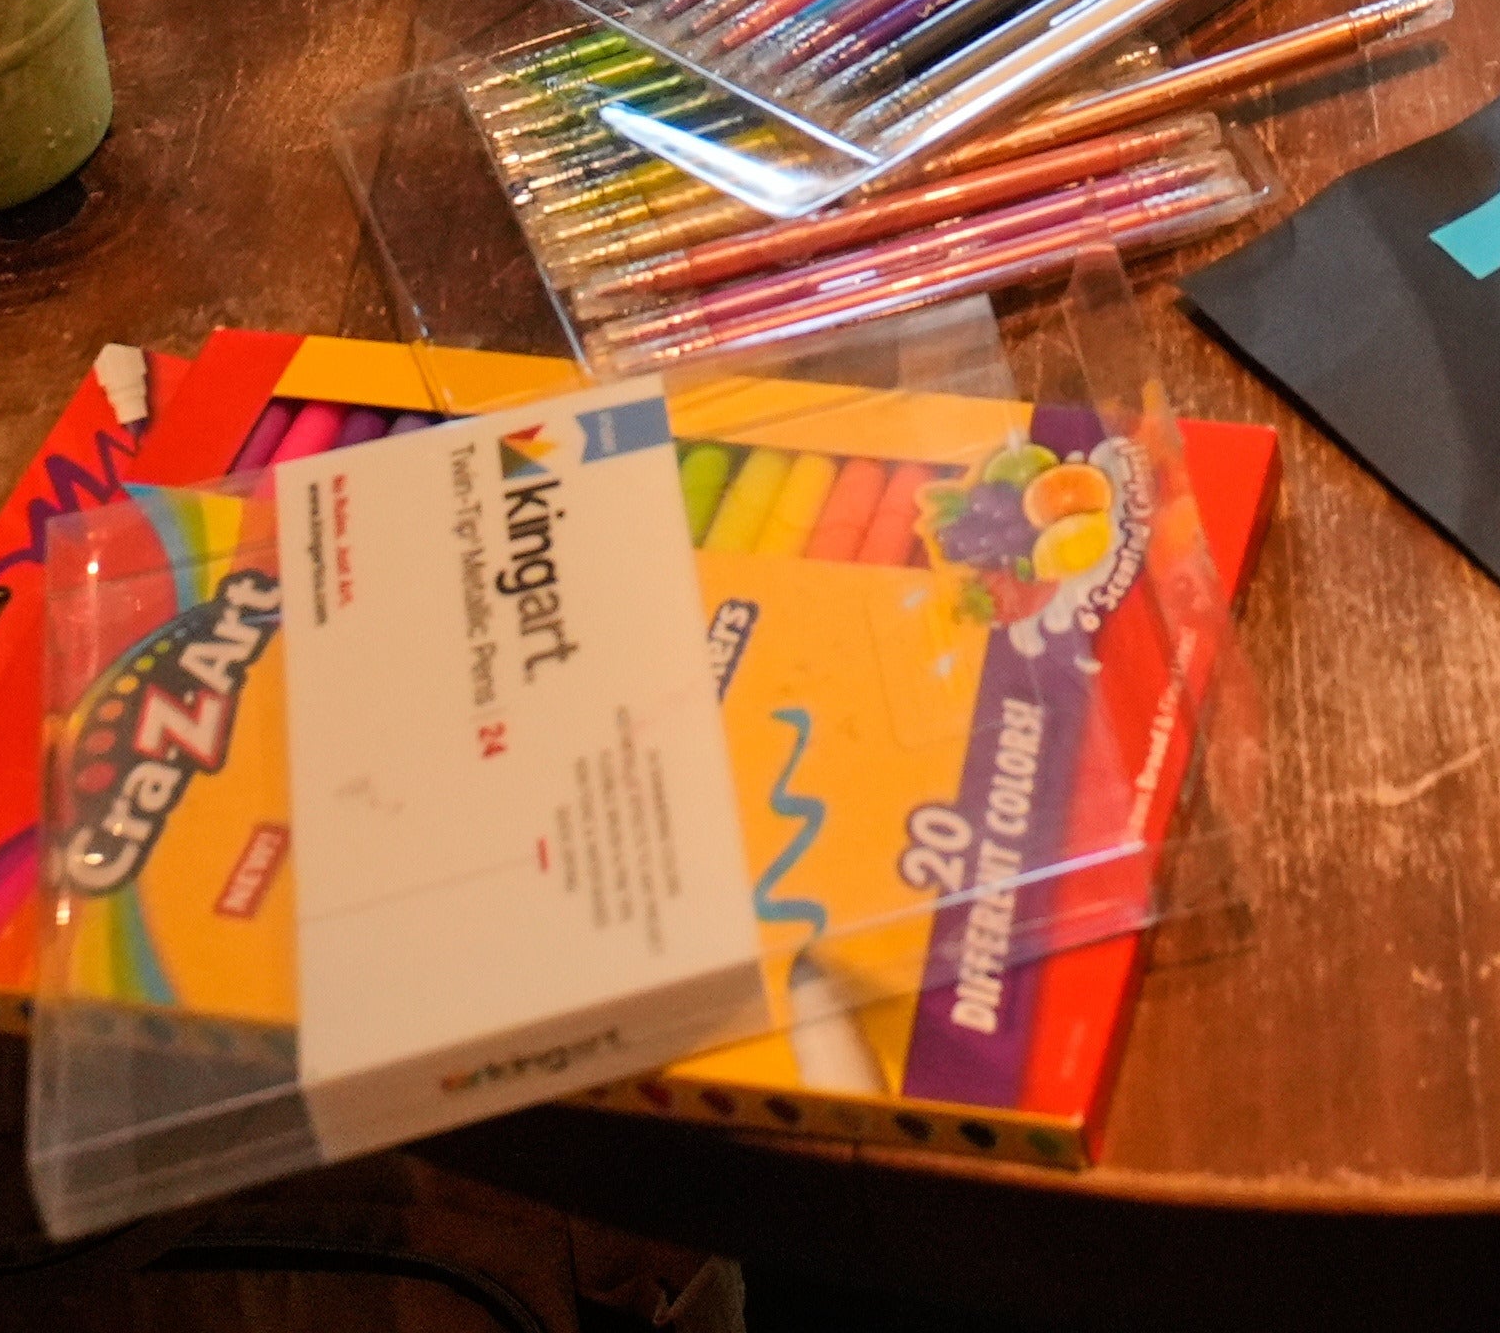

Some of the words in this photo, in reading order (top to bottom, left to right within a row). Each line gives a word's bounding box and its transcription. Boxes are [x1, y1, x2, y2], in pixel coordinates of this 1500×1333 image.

[495, 478, 580, 685] kingart
[468, 640, 499, 708] Pens
[475, 720, 509, 762] 24
[985, 697, 1045, 837] COLORS!
[900, 806, 974, 894] 20
[950, 837, 1021, 1033] DIFFERENT
